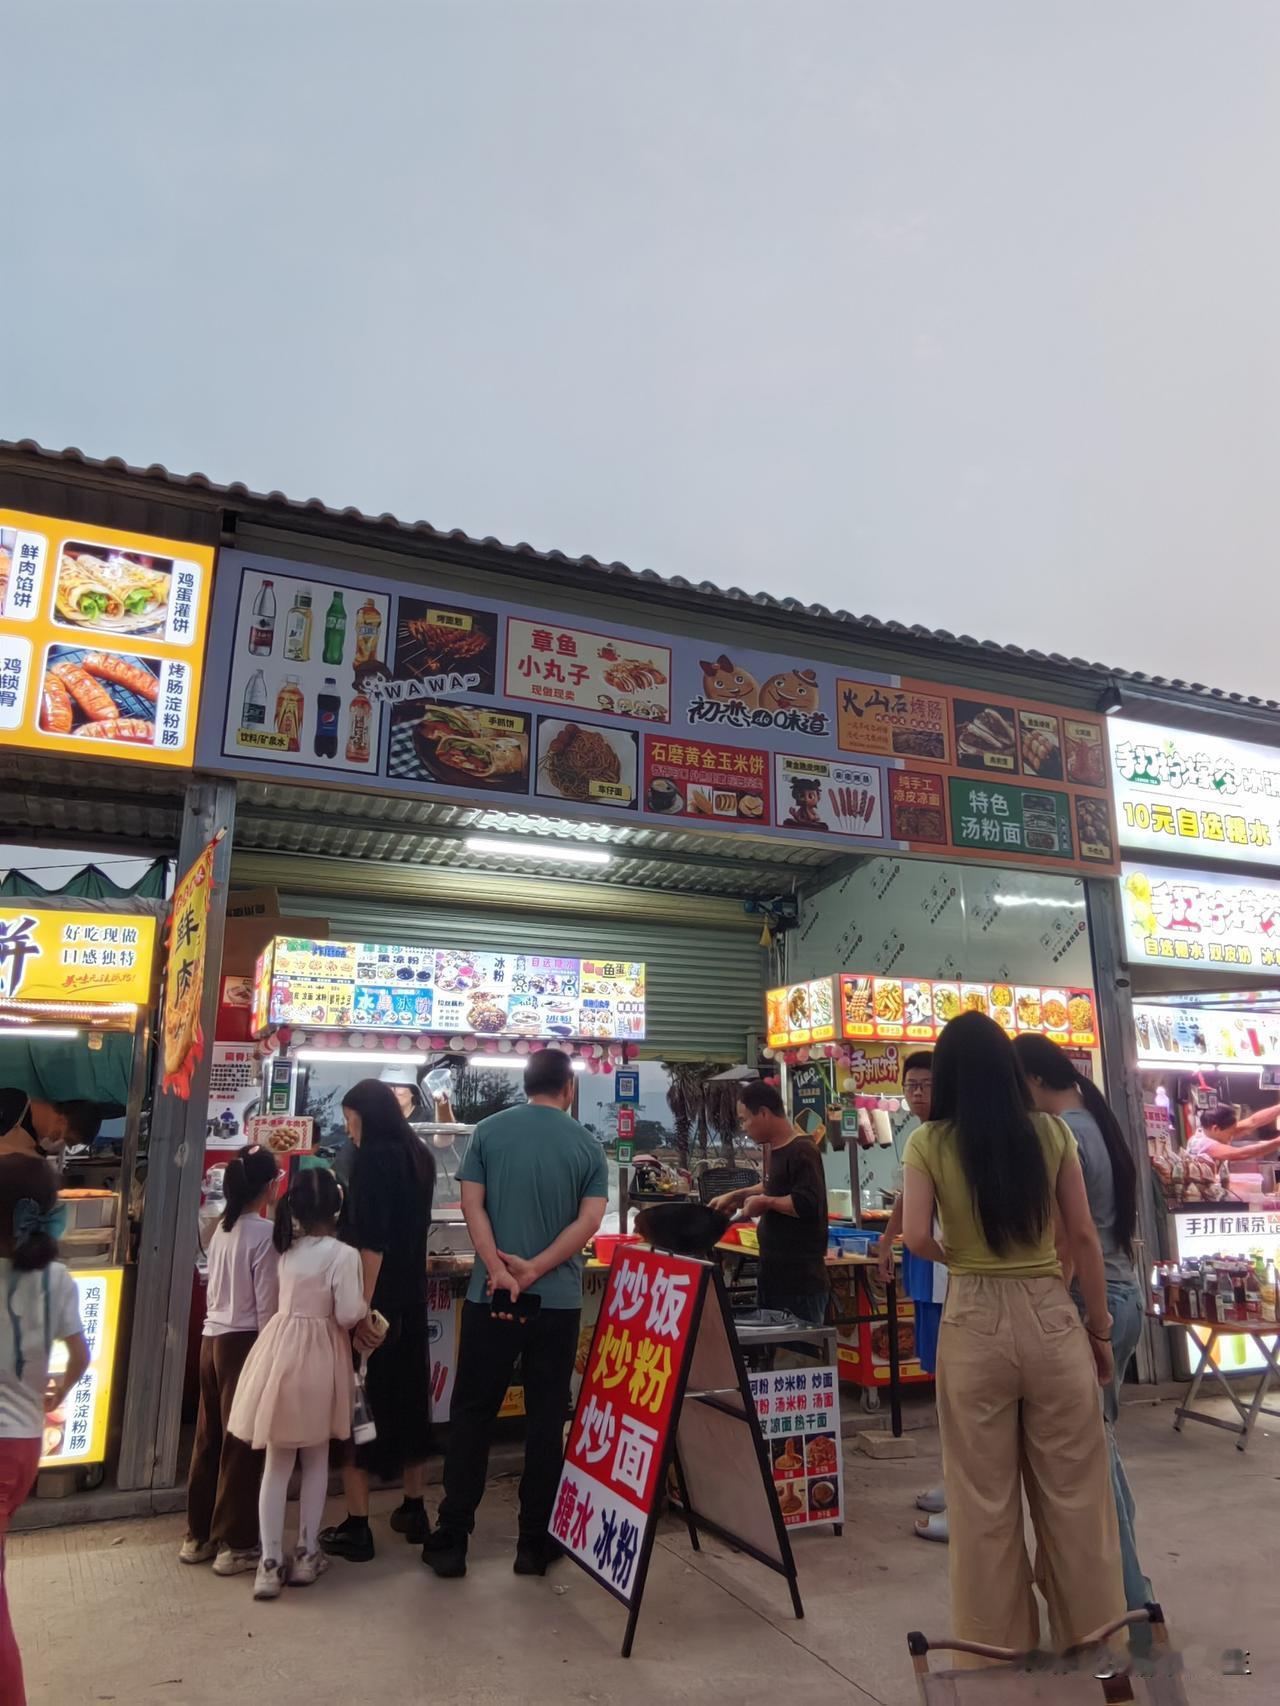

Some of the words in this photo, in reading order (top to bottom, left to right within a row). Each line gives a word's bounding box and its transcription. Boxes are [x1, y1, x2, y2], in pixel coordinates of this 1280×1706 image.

[13, 543, 39, 609] 鲜肉馅饼
[172, 572, 195, 635] 鸡蛋灌饼
[531, 629, 578, 658] 章鱼
[518, 655, 590, 686] 小丸子
[161, 662, 187, 746] 烤肠淀粉肠
[531, 684, 575, 701] 现做现卖
[488, 717, 515, 729] 手抓饼
[240, 732, 287, 747] 饮料/矿泉水
[652, 742, 765, 776] 石磨黄金玉米饼
[969, 789, 1009, 817] 特色
[961, 816, 1021, 846] 汤粉面
[1123, 802, 1272, 847] 10元自选糖水
[65, 925, 137, 944] 好吃现做
[64, 949, 135, 967] 口感独特
[494, 957, 504, 982] 冰粉
[851, 1050, 898, 1088] 手抓饼
[1186, 1217, 1265, 1235] 手打柠檬茶
[608, 1259, 691, 1341] 炒饭
[591, 1323, 672, 1413] 炒粉
[774, 1374, 806, 1393] 炒米粉
[812, 1372, 833, 1389] 炒面
[69, 1374, 93, 1449] 烤肠淀粉肠
[775, 1394, 807, 1412] 汤米粉
[813, 1392, 834, 1409] 汤面
[770, 1416, 792, 1433] 凉面
[794, 1412, 827, 1431] 热干面
[576, 1395, 659, 1499] 炒面
[553, 1476, 594, 1551] 糖水
[593, 1508, 639, 1590] 冰粉
